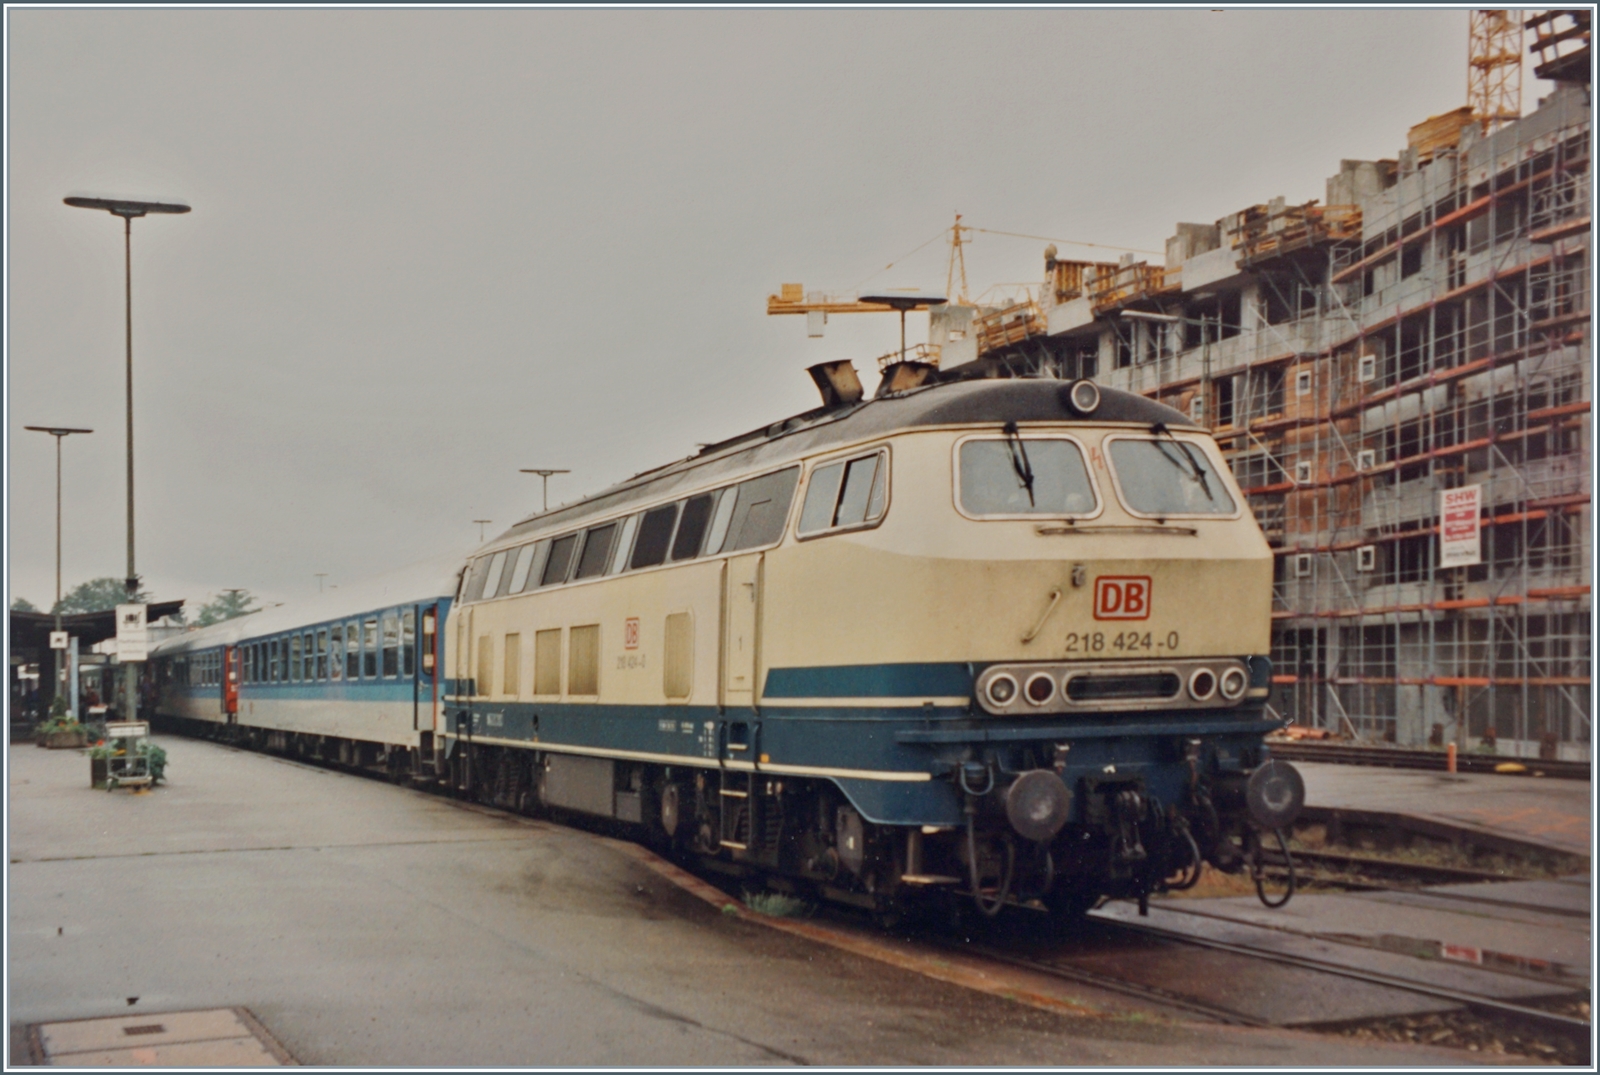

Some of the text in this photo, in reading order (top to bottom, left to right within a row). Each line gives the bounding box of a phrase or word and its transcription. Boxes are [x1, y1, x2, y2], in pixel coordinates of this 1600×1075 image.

[1445, 490, 1477, 504] SHW
[1100, 581, 1146, 614] DB
[626, 620, 638, 646] DB
[1065, 632, 1105, 652] 218
